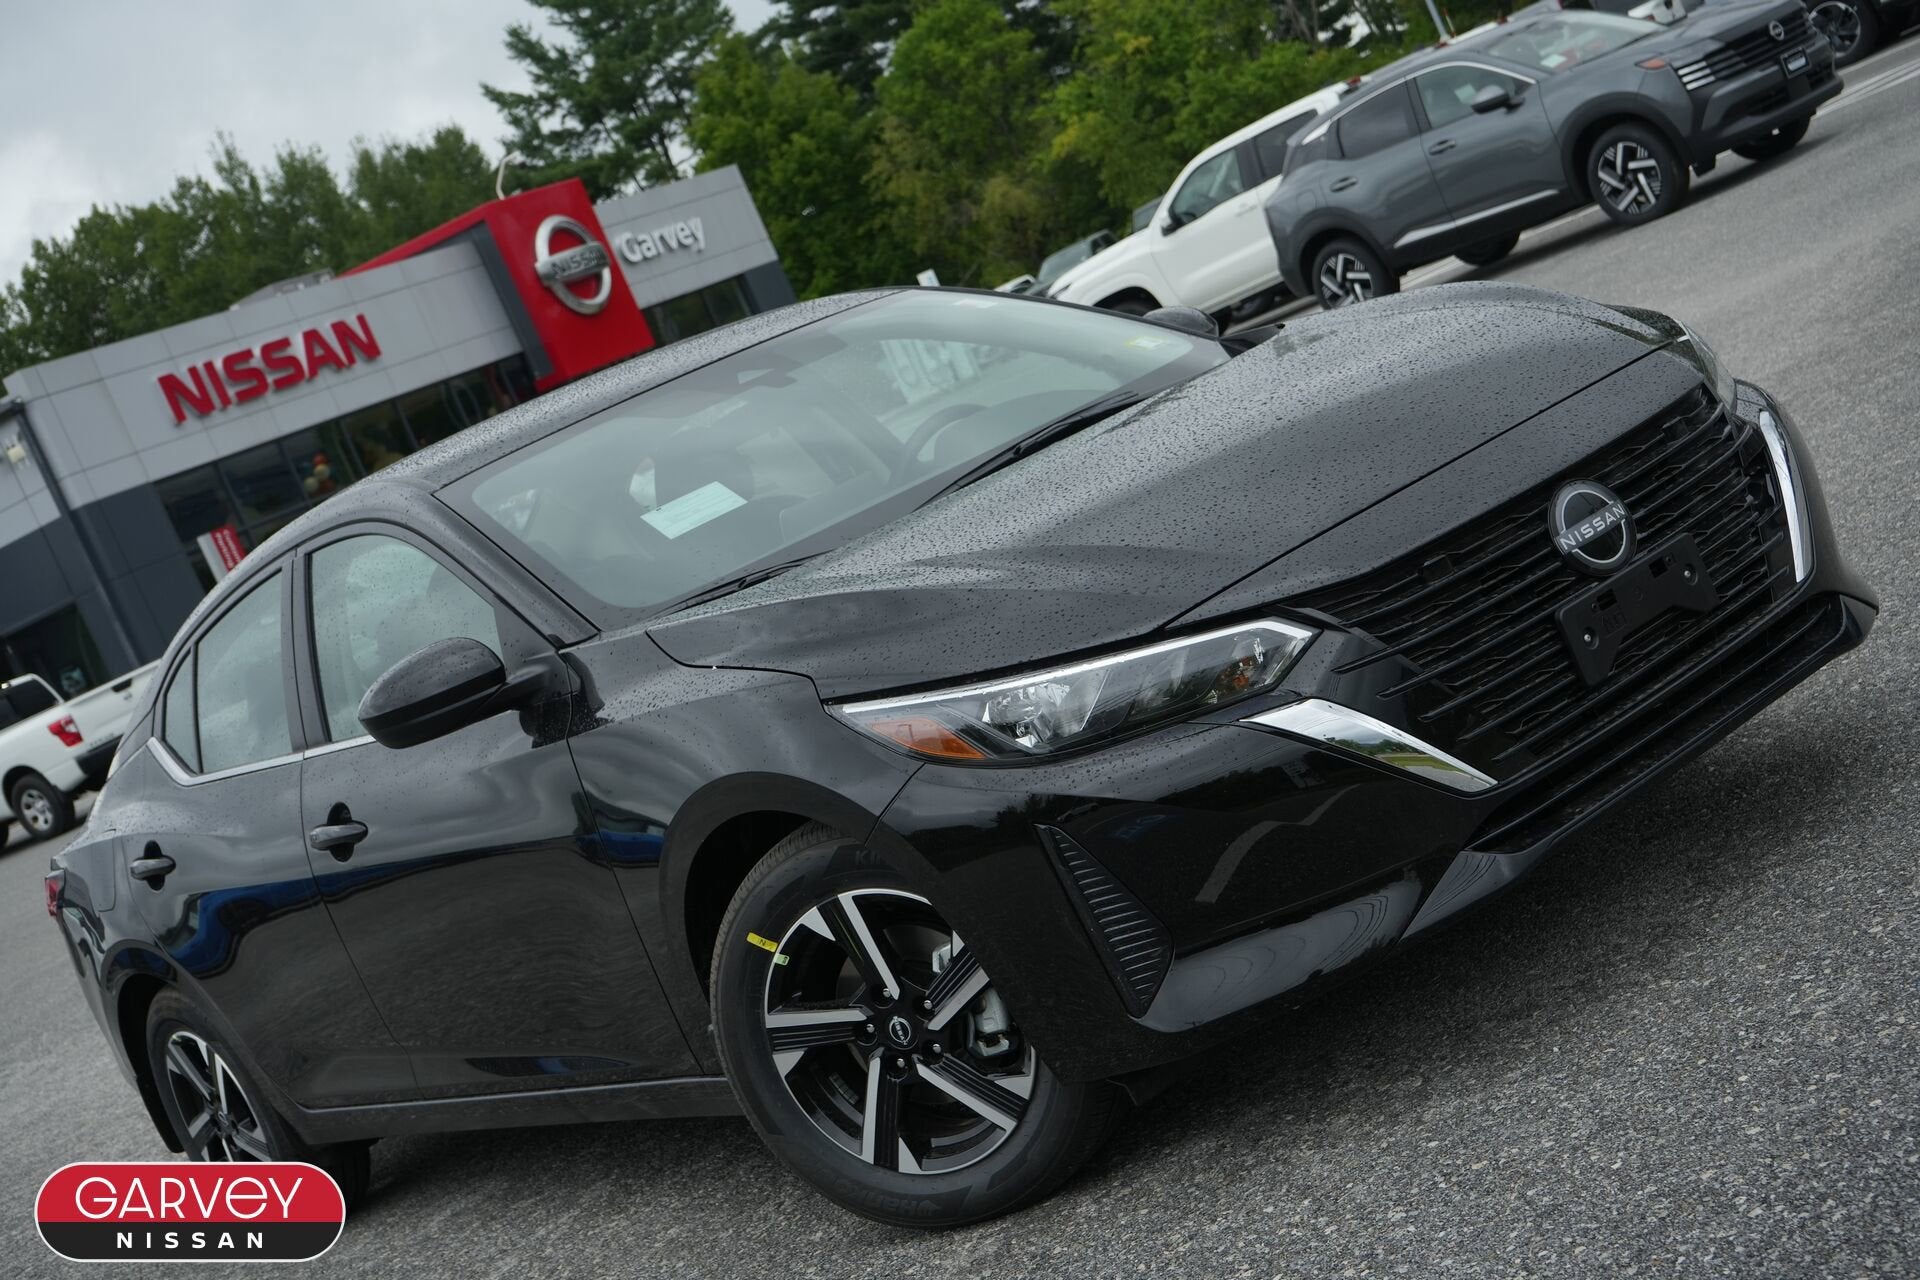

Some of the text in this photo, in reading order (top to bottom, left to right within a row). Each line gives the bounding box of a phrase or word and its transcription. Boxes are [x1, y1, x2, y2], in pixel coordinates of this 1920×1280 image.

[620, 216, 706, 263] Garvey
[157, 313, 382, 425] NISSAN
[1560, 503, 1626, 550] NISSAN
